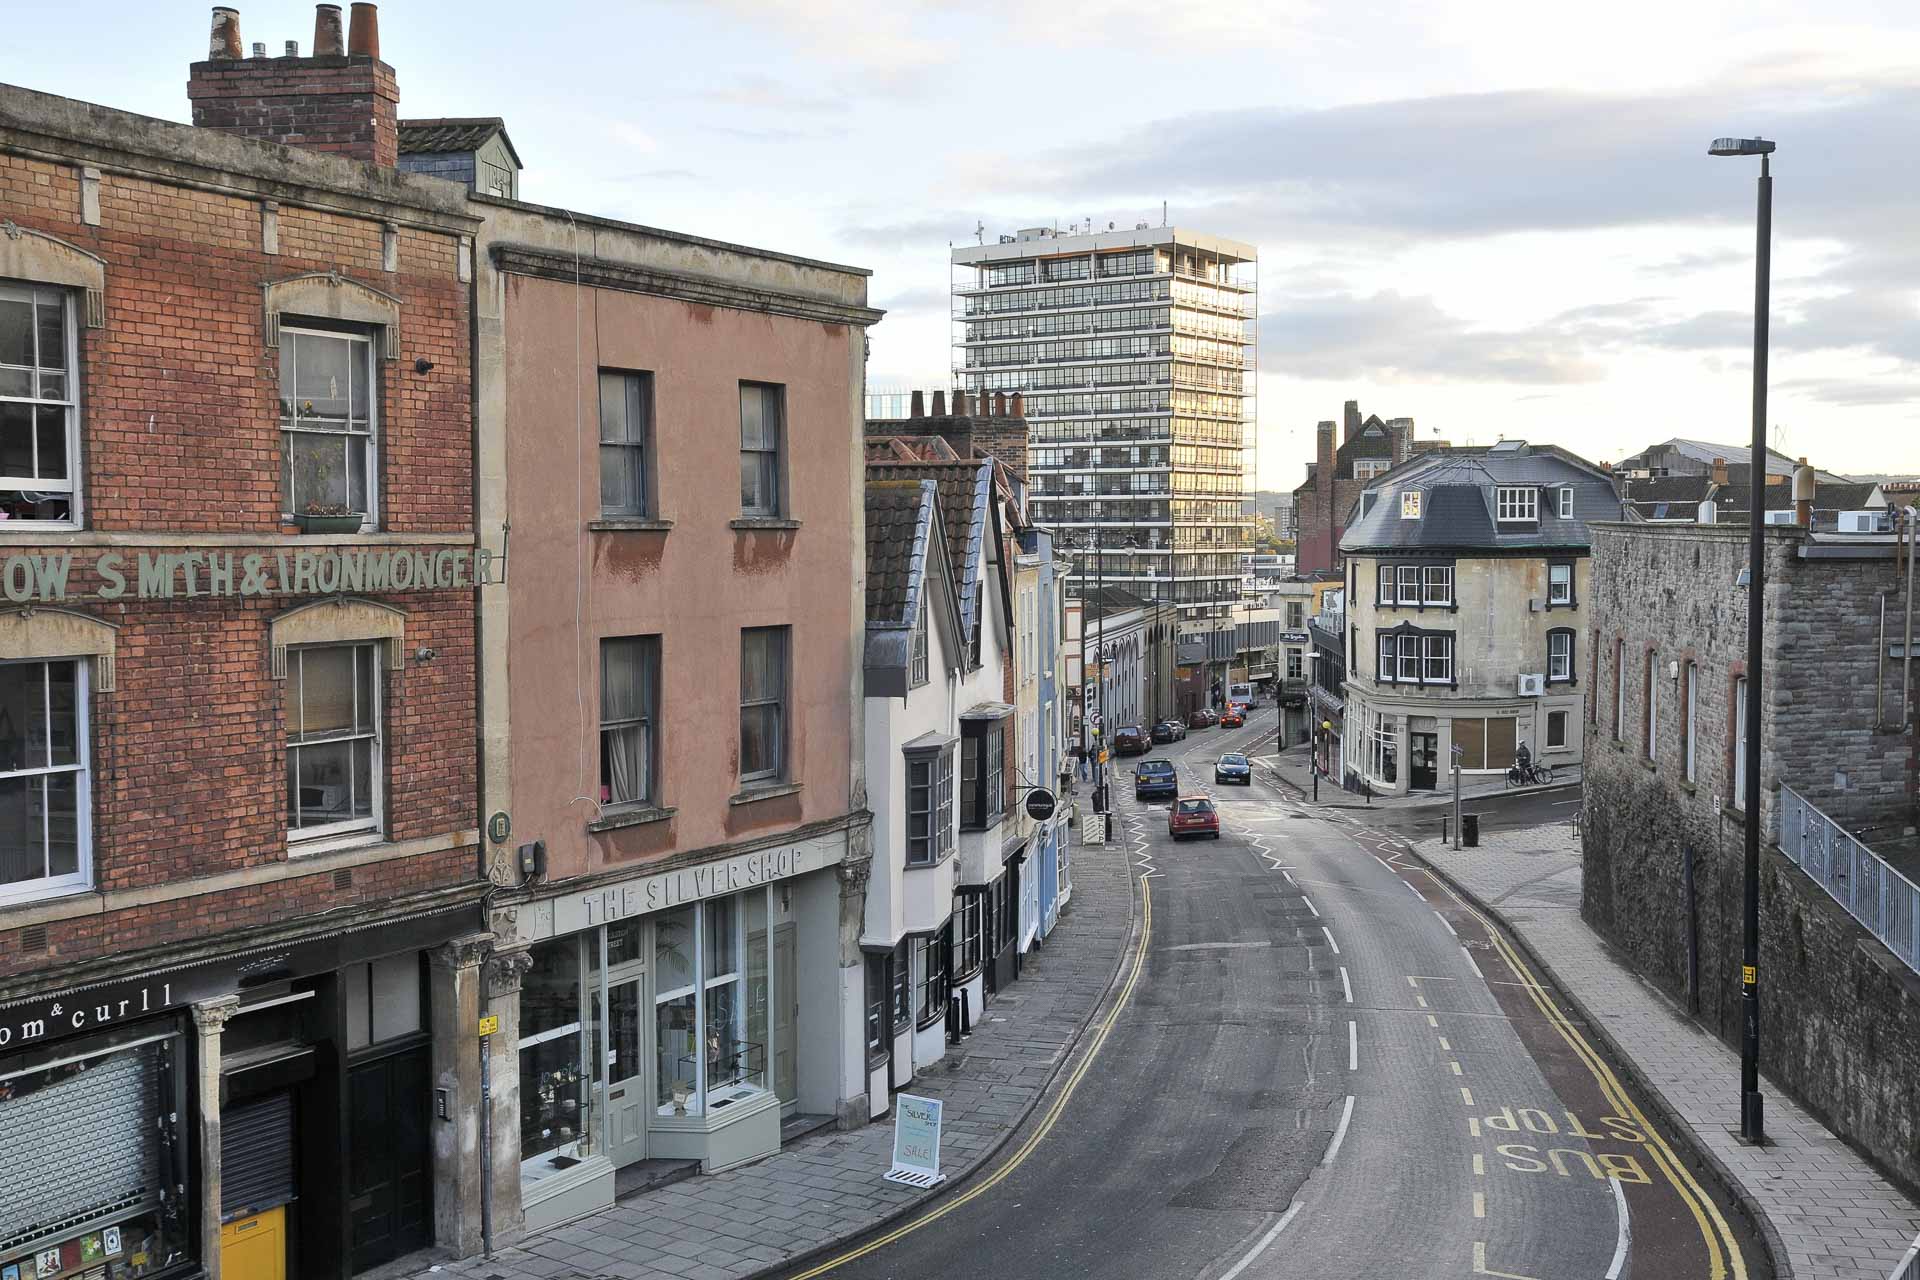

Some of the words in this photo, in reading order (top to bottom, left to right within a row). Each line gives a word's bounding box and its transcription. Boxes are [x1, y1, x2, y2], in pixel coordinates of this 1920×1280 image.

[240, 554, 273, 596] &
[277, 548, 494, 594] IRONMONGER
[583, 886, 639, 925] THE
[646, 863, 740, 910] SILVER
[747, 847, 801, 884] SHOP
[0, 1019, 45, 1045] om
[51, 1003, 63, 1016] &
[72, 984, 172, 1027] curll
[1484, 1106, 1646, 1143] STOP
[1497, 1144, 1653, 1185] BUS
